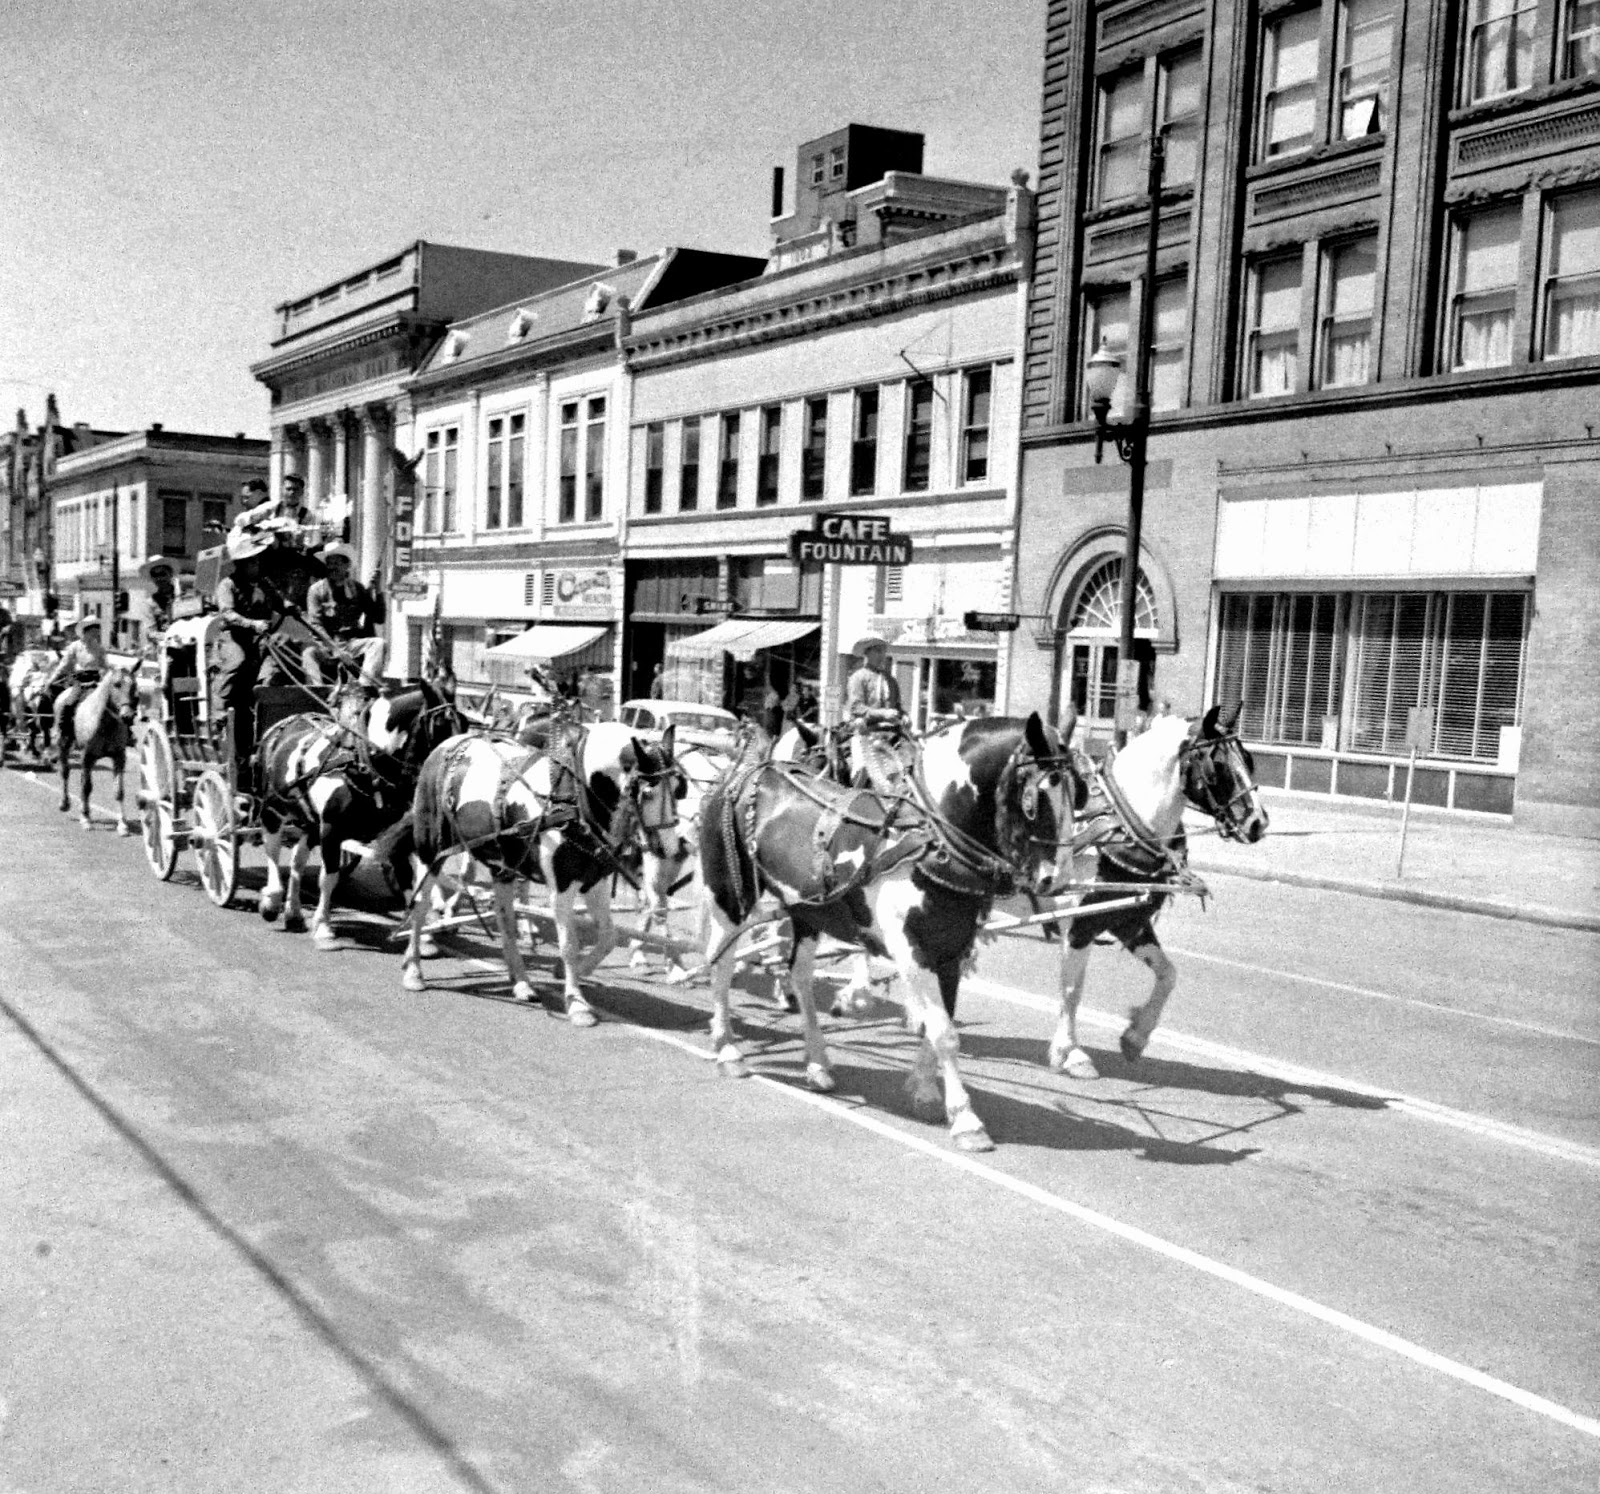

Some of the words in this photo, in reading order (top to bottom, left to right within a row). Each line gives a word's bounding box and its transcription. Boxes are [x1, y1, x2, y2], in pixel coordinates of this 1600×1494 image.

[396, 496, 412, 567] FOE
[822, 518, 887, 540] CAFE
[801, 542, 906, 562] FOUNTAIN
